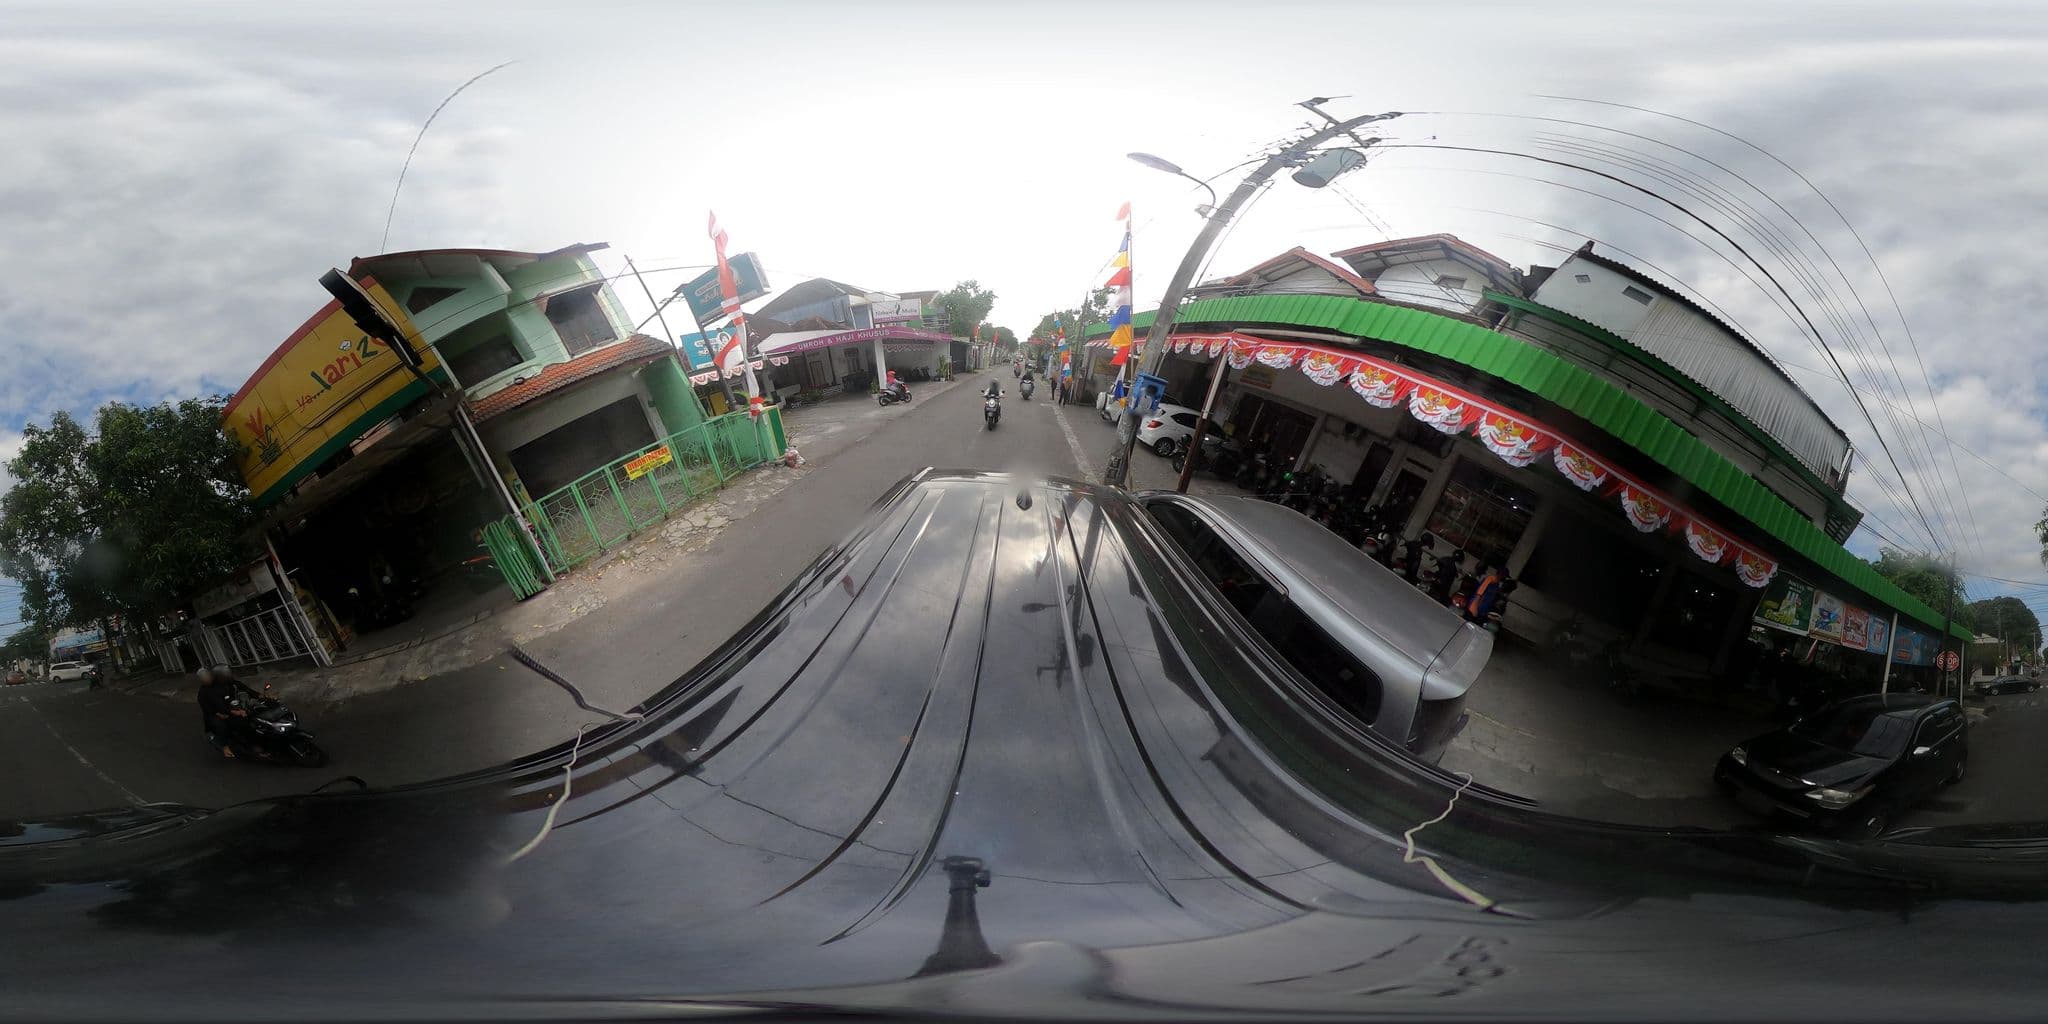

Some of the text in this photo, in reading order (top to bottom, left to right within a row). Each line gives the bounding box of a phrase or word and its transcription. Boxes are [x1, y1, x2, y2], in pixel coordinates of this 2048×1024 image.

[798, 340, 824, 350] UMROH
[836, 333, 855, 342] HAJI
[1938, 656, 1957, 665] SOP
